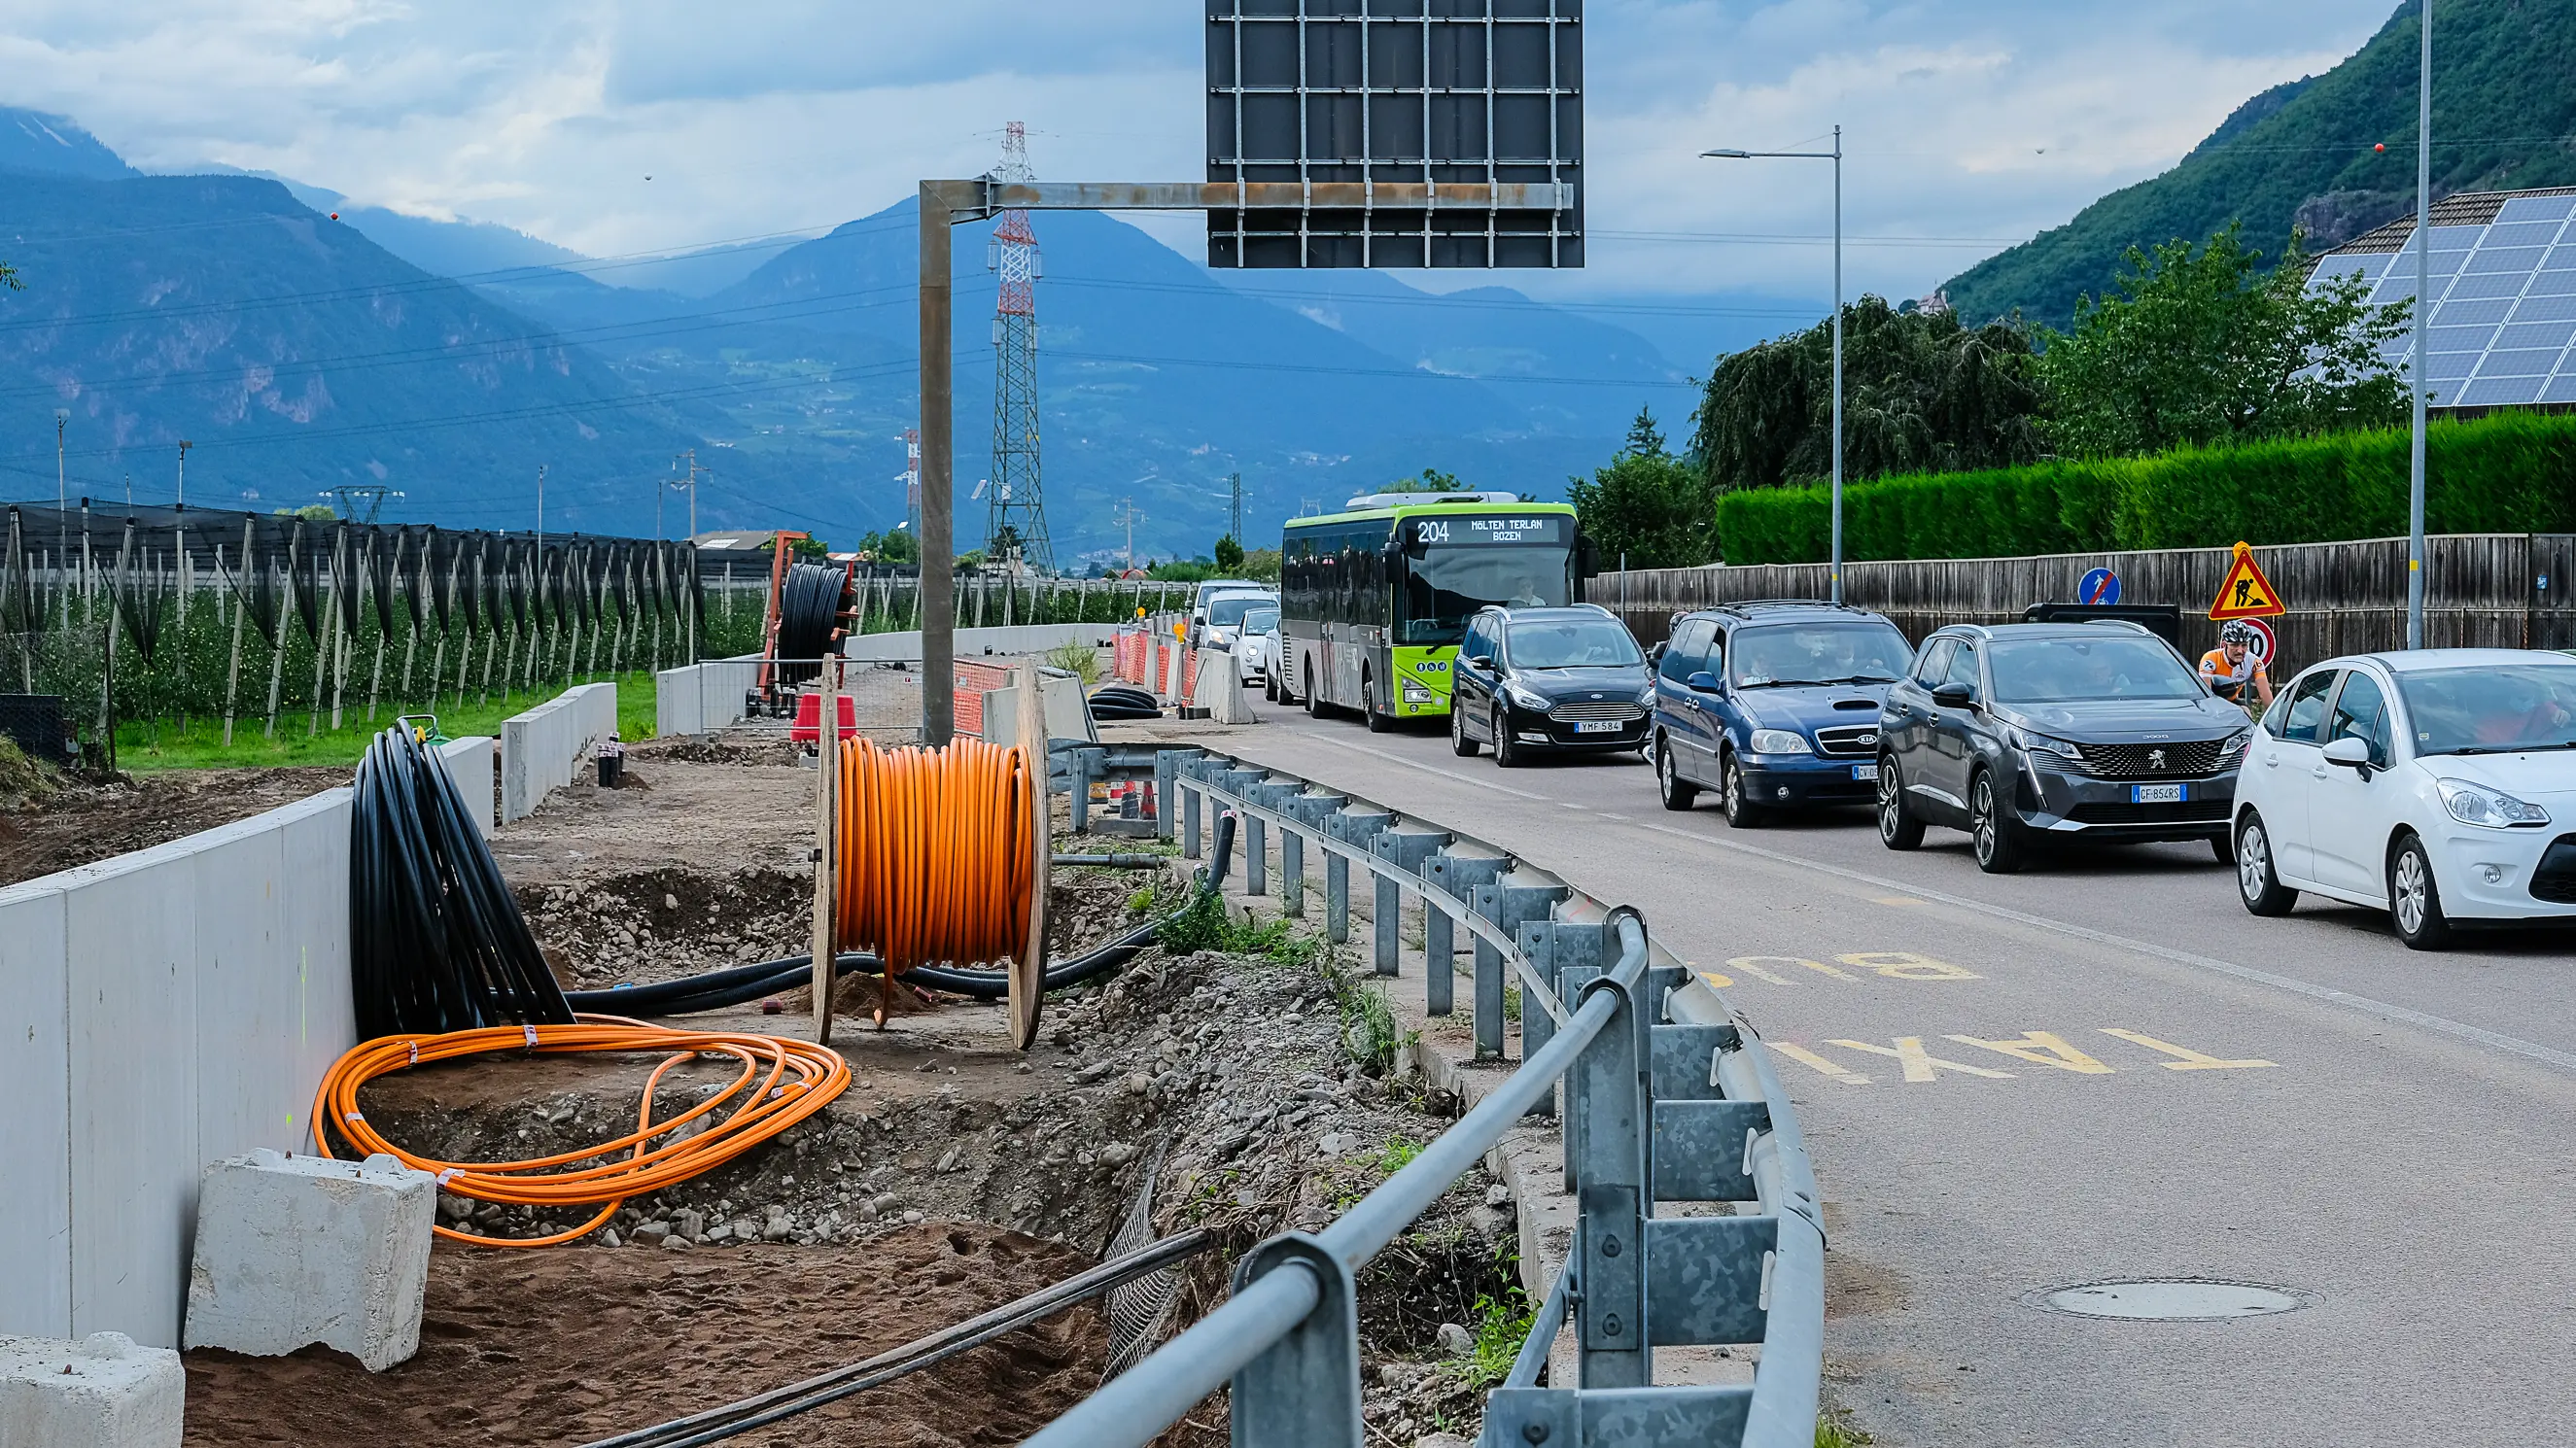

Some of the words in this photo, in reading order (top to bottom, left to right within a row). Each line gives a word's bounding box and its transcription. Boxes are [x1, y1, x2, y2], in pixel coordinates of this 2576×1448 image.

[1510, 519, 1543, 530] TERLAN
[1417, 521, 1449, 542] 204
[1492, 531, 1521, 541] BOZEN
[1582, 722, 1599, 731] YMF
[1601, 722, 1619, 731] 584
[1764, 1027, 2281, 1086] TAXI
